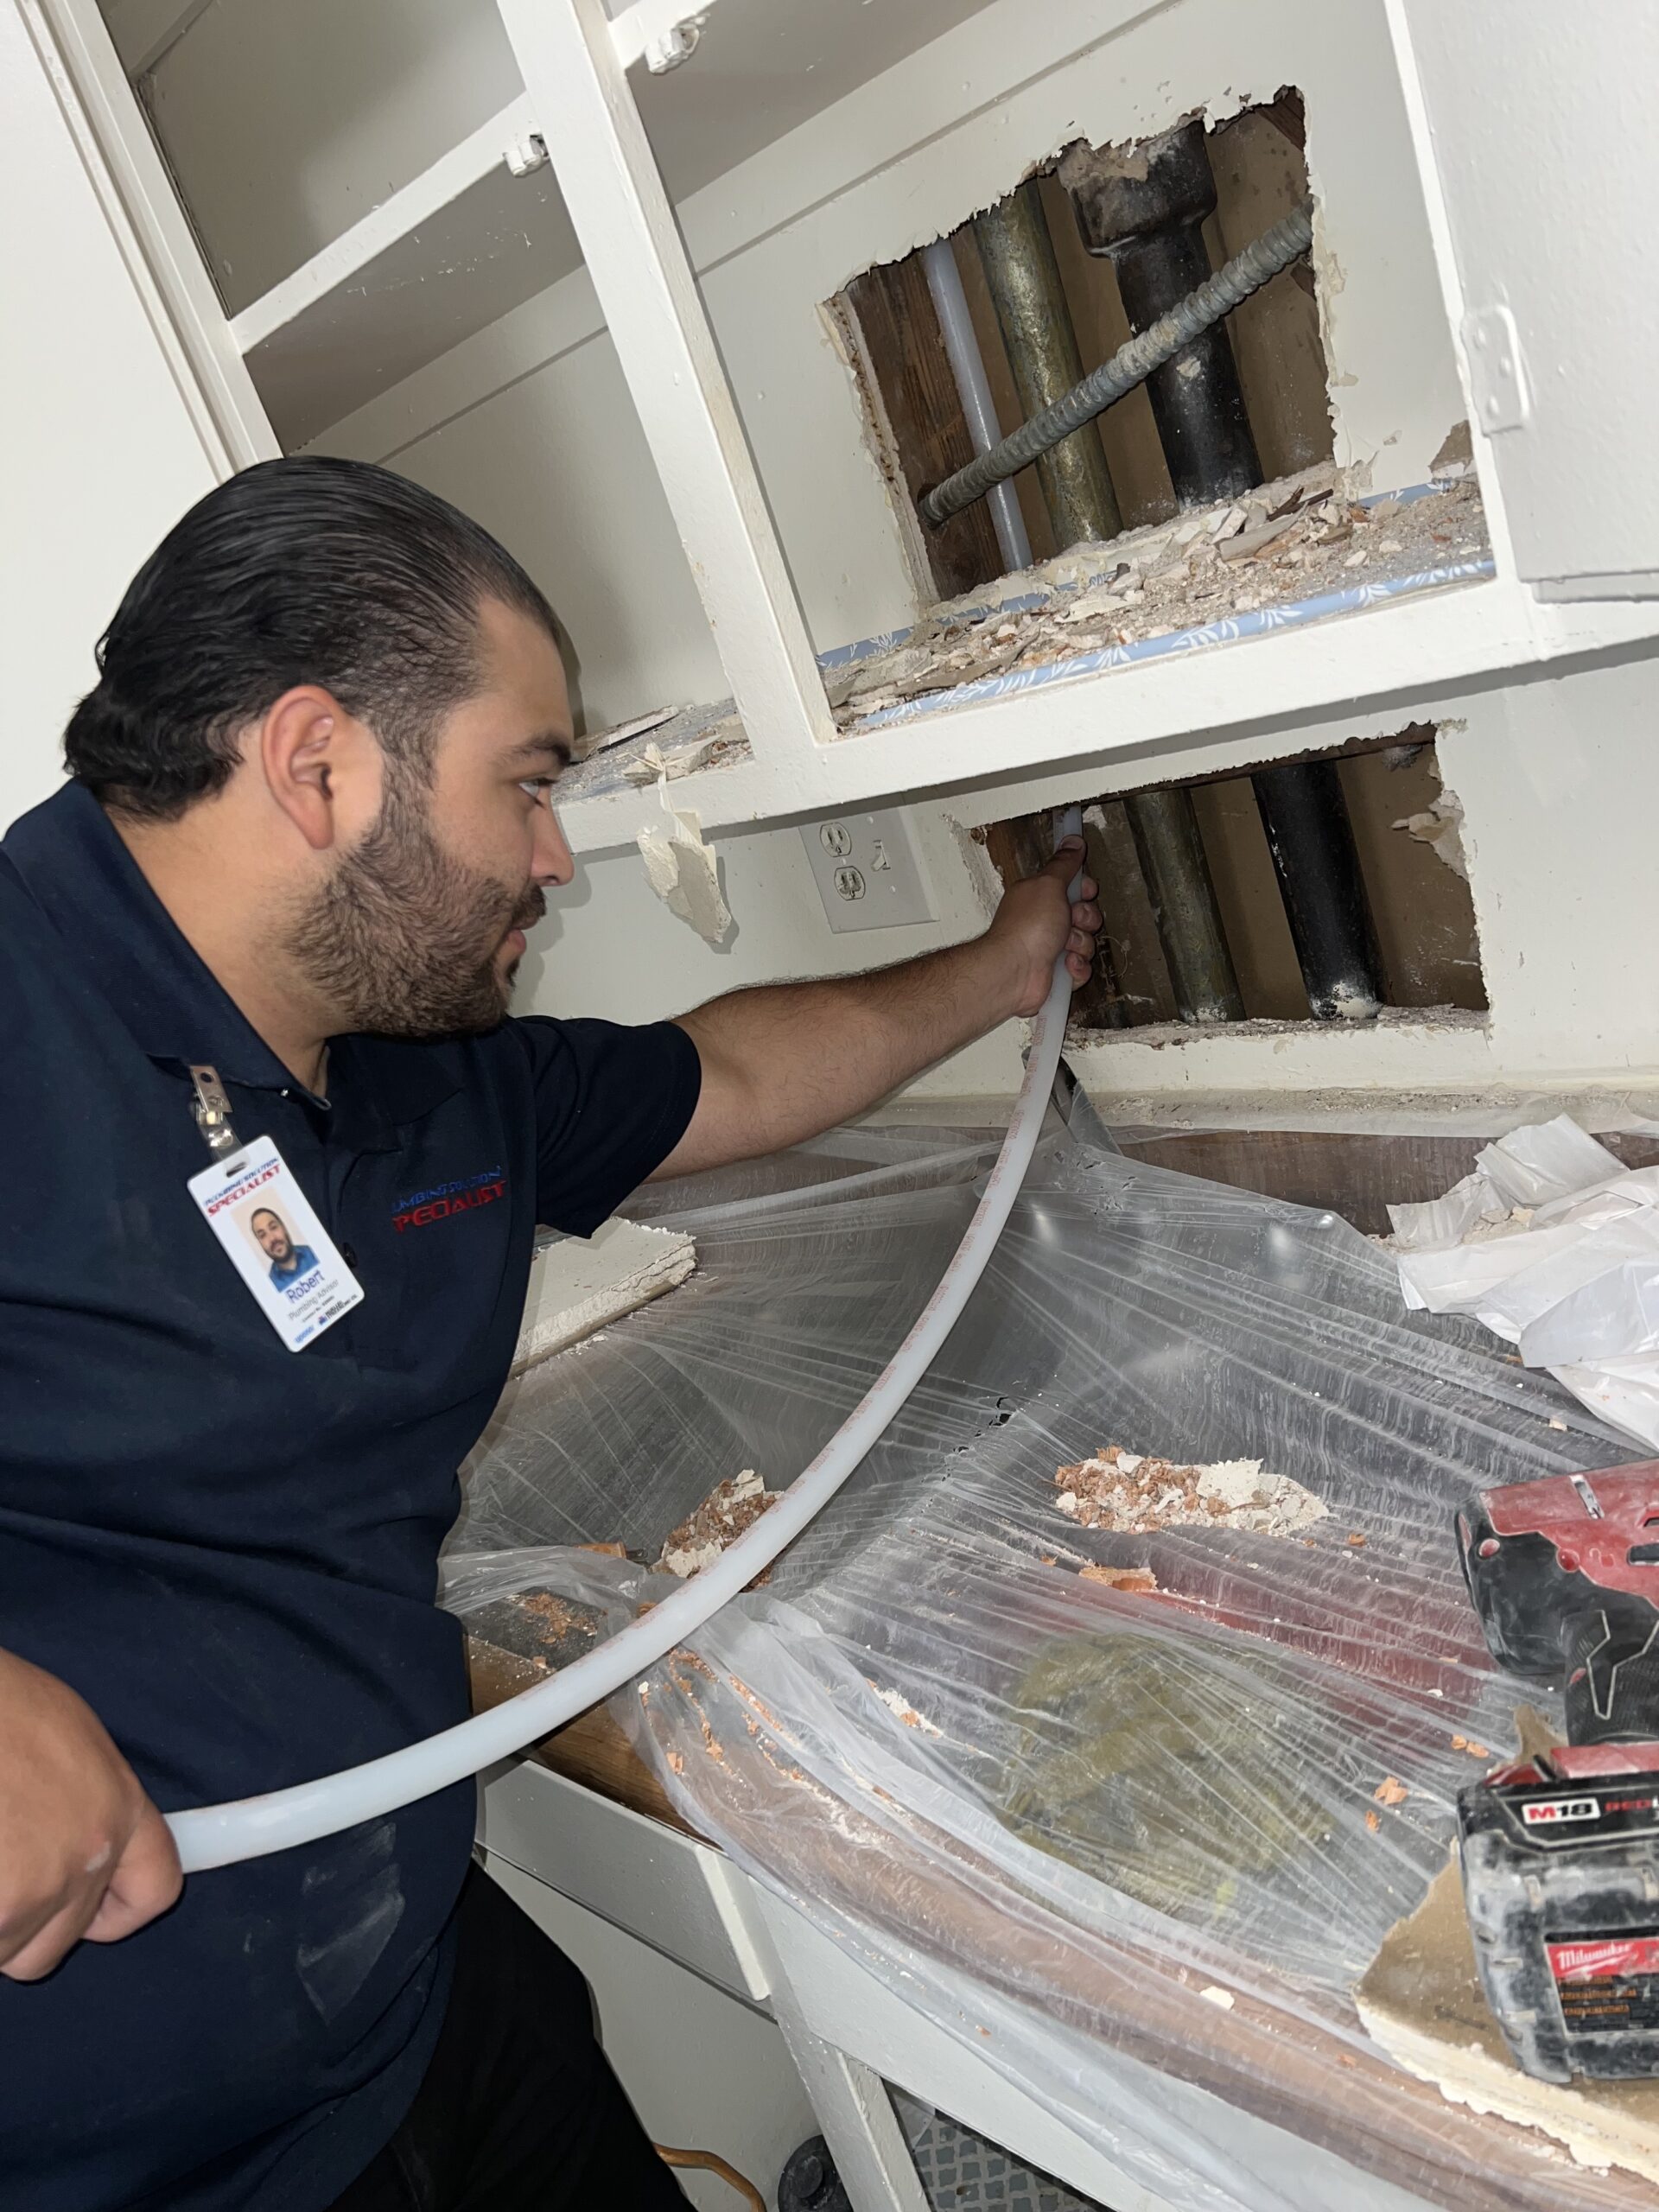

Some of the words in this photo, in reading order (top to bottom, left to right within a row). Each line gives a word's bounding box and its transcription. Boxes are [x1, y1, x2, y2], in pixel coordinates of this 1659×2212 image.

[207, 1164, 280, 1217] SPECIALIST
[286, 1270, 325, 1303] Robert
[288, 1297, 318, 1320] Plumbing
[317, 1280, 339, 1299] Advisor
[1528, 1803, 1592, 1820] M18
